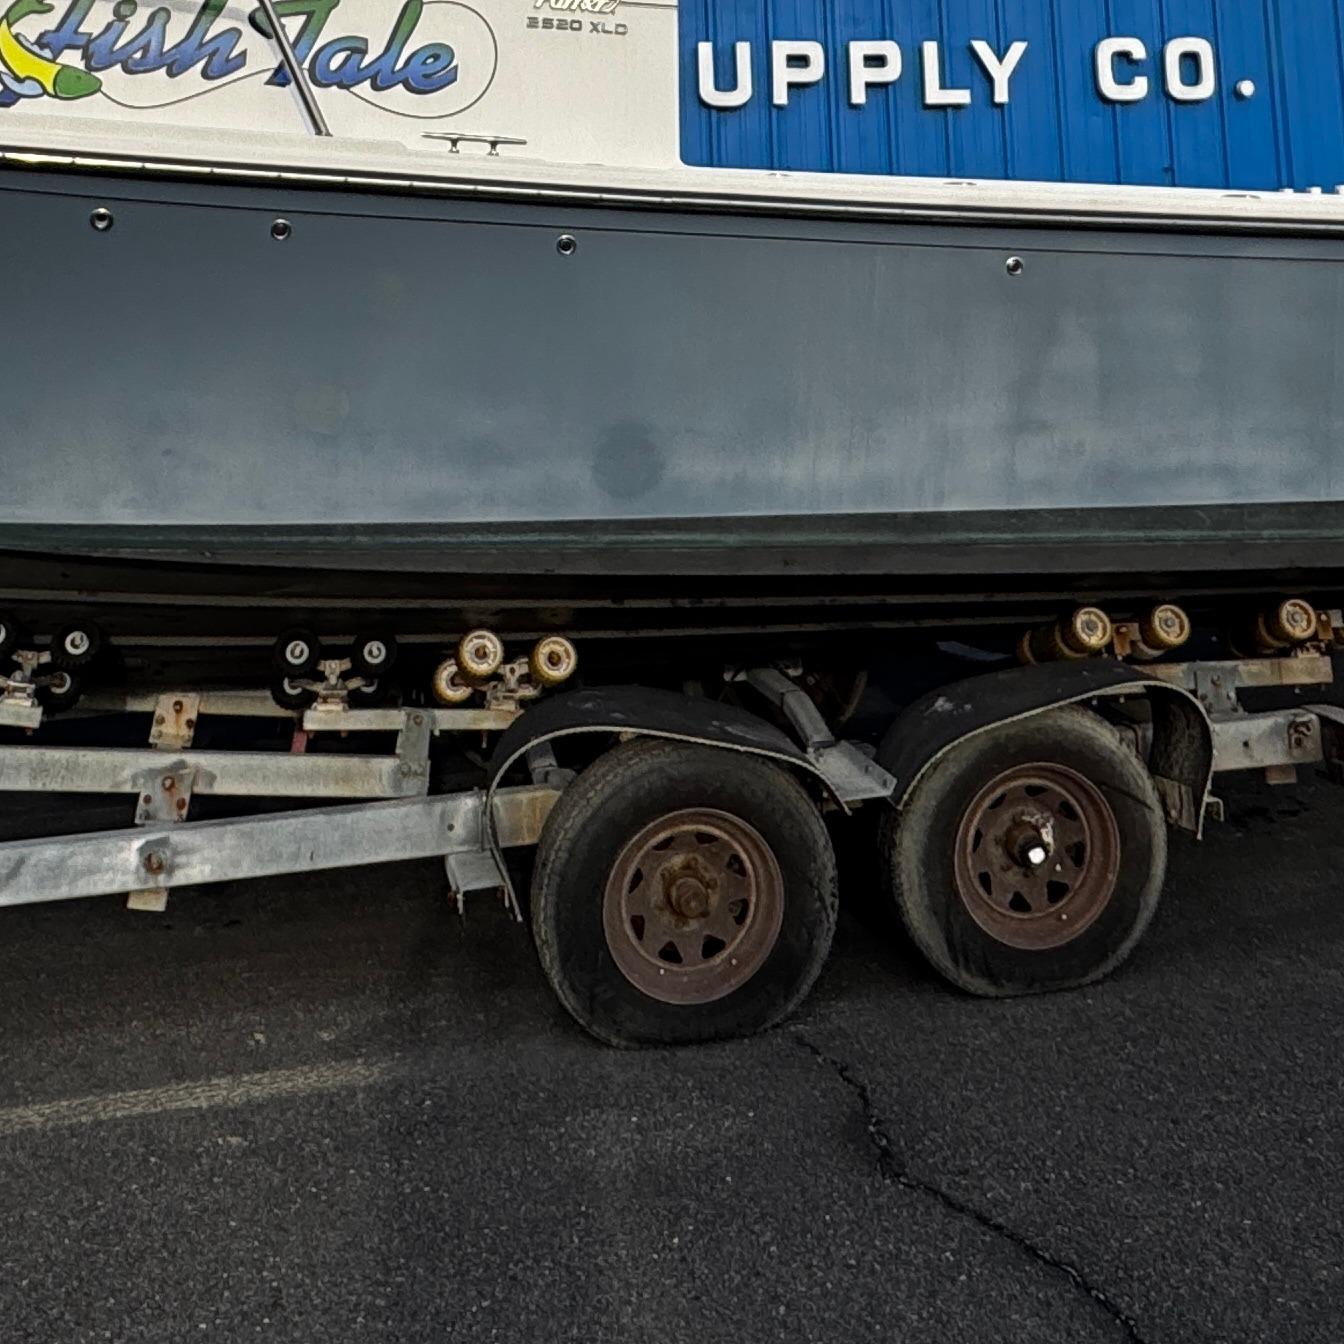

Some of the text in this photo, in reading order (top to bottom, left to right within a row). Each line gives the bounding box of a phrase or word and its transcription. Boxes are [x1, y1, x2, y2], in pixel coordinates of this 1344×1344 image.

[589, 21, 629, 36] XLD
[697, 36, 1256, 108] UPPLY CO.
